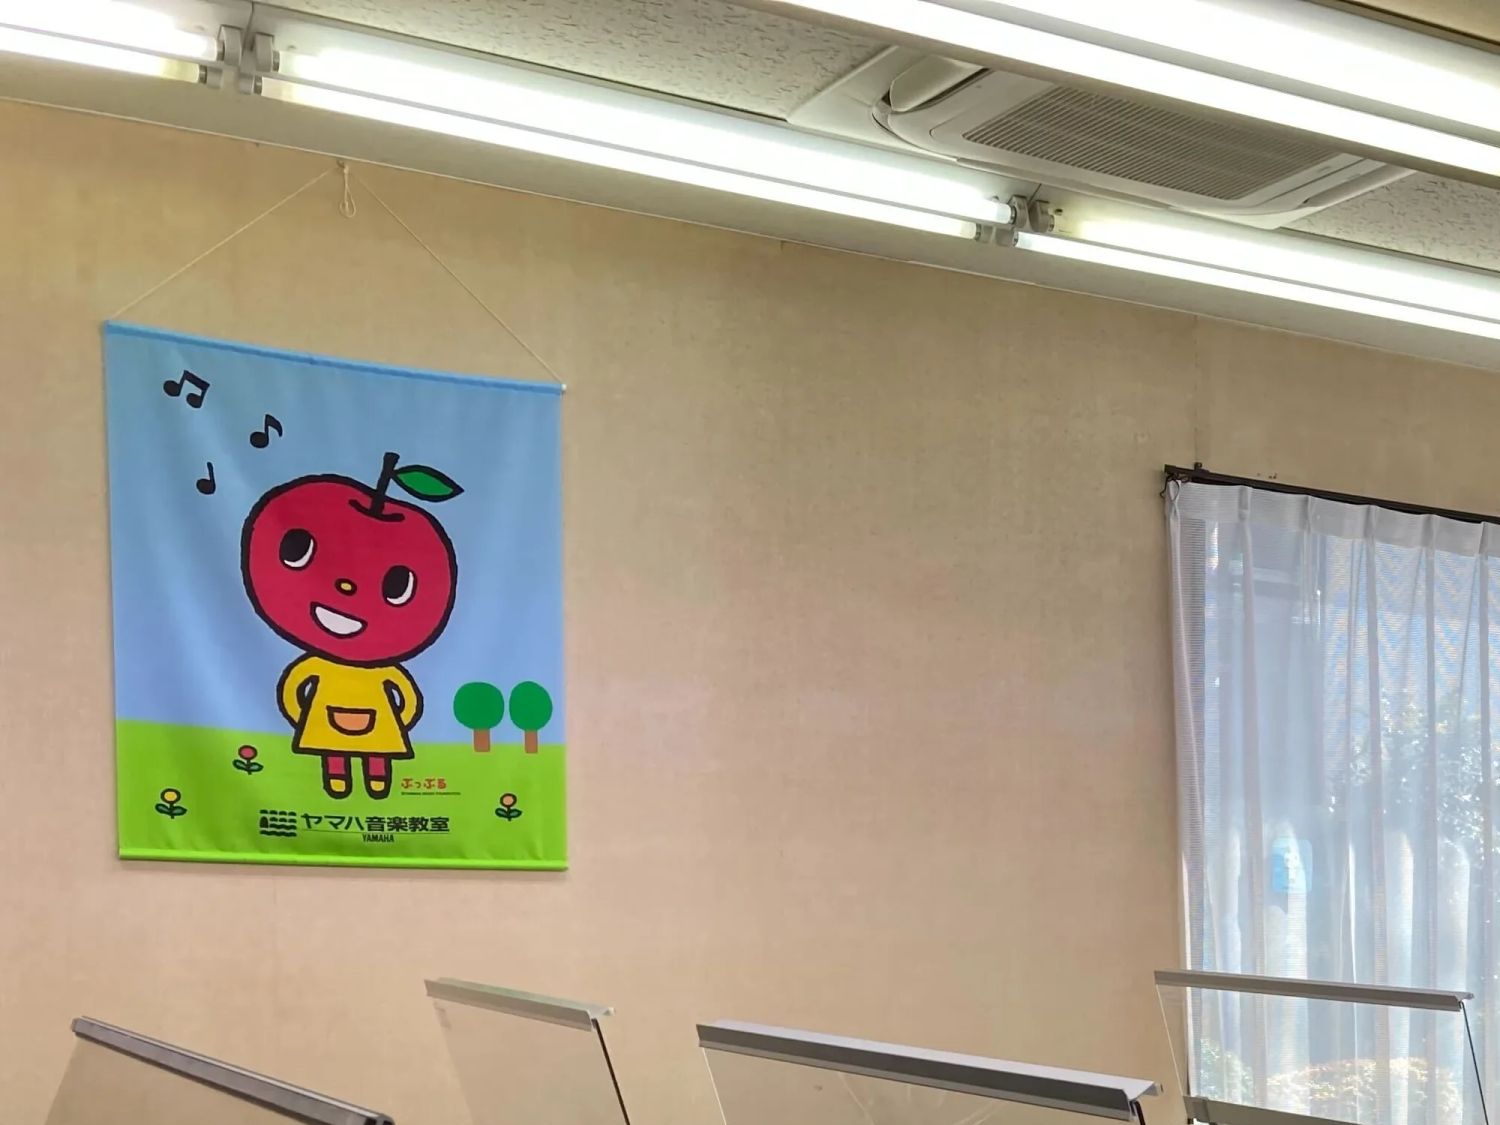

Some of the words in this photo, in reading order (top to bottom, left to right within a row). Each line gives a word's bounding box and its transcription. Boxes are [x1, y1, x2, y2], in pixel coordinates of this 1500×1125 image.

[301, 813, 450, 833] ヤマハ音楽教室
[362, 834, 395, 844] YAMAHA
